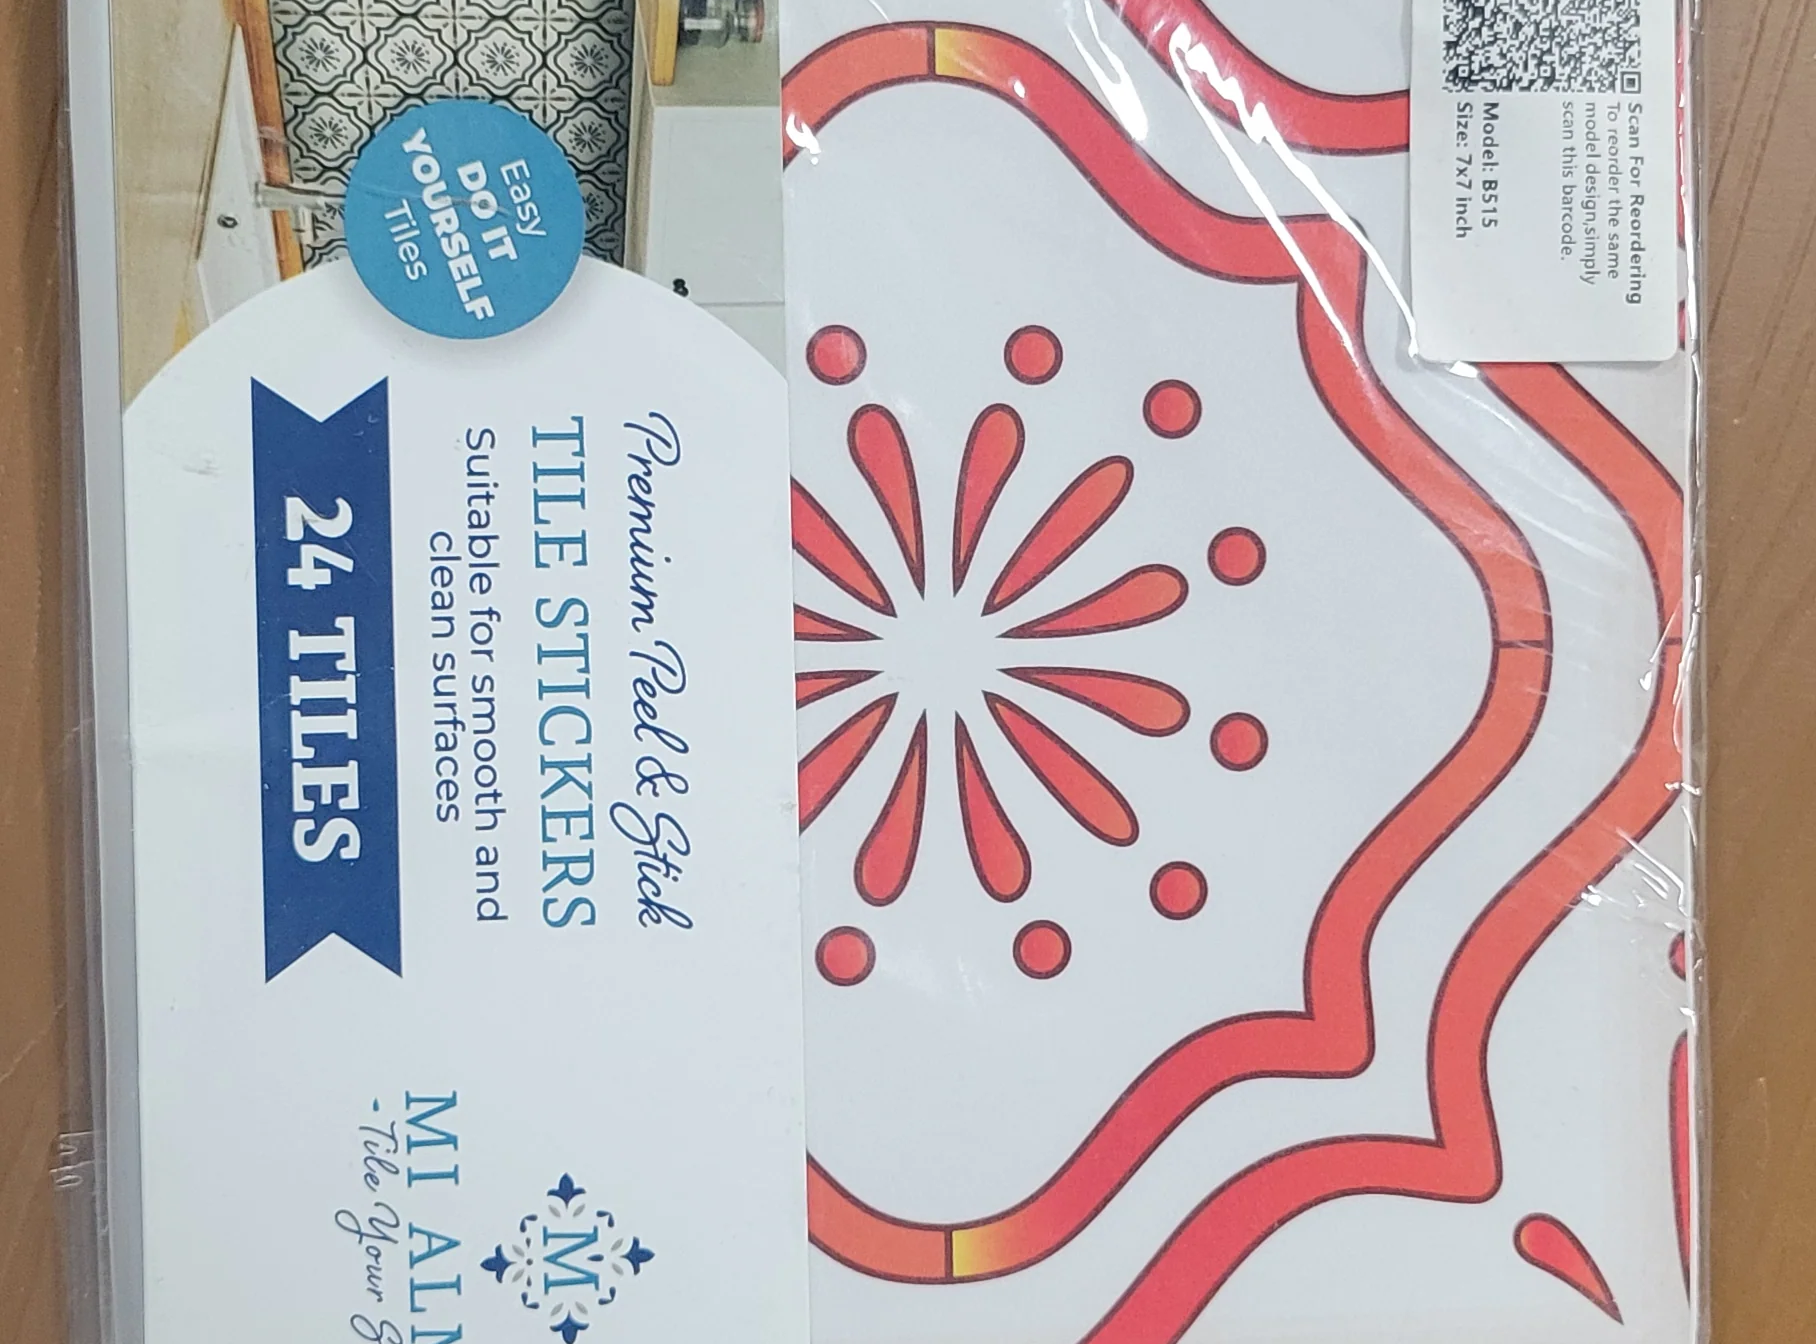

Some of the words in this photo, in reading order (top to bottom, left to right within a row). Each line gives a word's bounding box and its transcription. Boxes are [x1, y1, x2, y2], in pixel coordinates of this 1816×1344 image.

[1456, 101, 1474, 148] Size:
[1482, 102, 1500, 172] Model:
[1562, 101, 1574, 140] scan
[1584, 102, 1602, 158] model
[1606, 101, 1621, 122] To
[1627, 102, 1643, 149] Scan
[500, 158, 547, 236] Easy
[1455, 153, 1473, 190] 7x7
[1561, 146, 1577, 178] this
[1607, 128, 1624, 194] reorder
[1629, 155, 1645, 188] For
[384, 198, 428, 281] Tiles
[402, 127, 495, 320] YOURSELF
[457, 160, 498, 219] DO
[481, 225, 518, 261] IT
[1455, 197, 1473, 238] inch
[1481, 179, 1499, 228] B515
[1560, 184, 1578, 261] barcode.
[1607, 199, 1624, 228] the
[1607, 232, 1620, 280] same
[1625, 194, 1647, 305] Reordering
[465, 427, 500, 595] Suitable
[531, 415, 588, 569] TILE
[623, 411, 681, 633] Premium
[285, 496, 354, 590] 24
[429, 531, 461, 639] clean
[469, 606, 502, 663] for
[628, 640, 690, 753] Peel
[288, 616, 361, 862] TILES
[432, 652, 467, 823] surfaces
[471, 674, 506, 831] smooth
[535, 597, 596, 928] STICKERS
[635, 755, 689, 798] &
[475, 845, 509, 922] and
[609, 801, 694, 930] Stick
[404, 1090, 460, 1189] MI
[334, 1201, 401, 1303] Your
